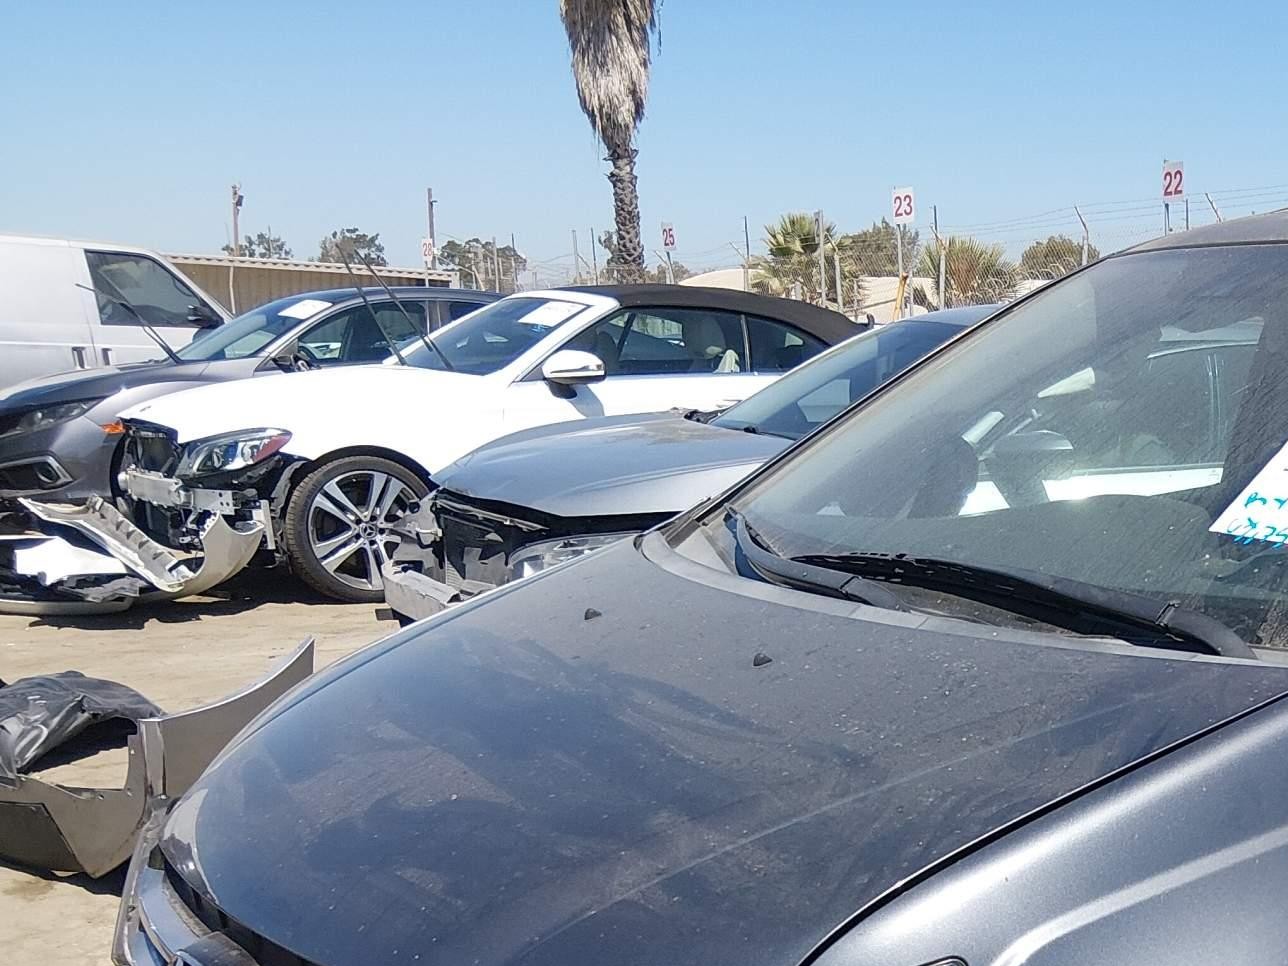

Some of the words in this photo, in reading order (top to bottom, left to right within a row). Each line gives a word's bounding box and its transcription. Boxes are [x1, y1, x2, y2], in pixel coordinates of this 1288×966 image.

[1163, 169, 1183, 196] 22
[893, 194, 913, 218] 23
[662, 228, 675, 247] 25
